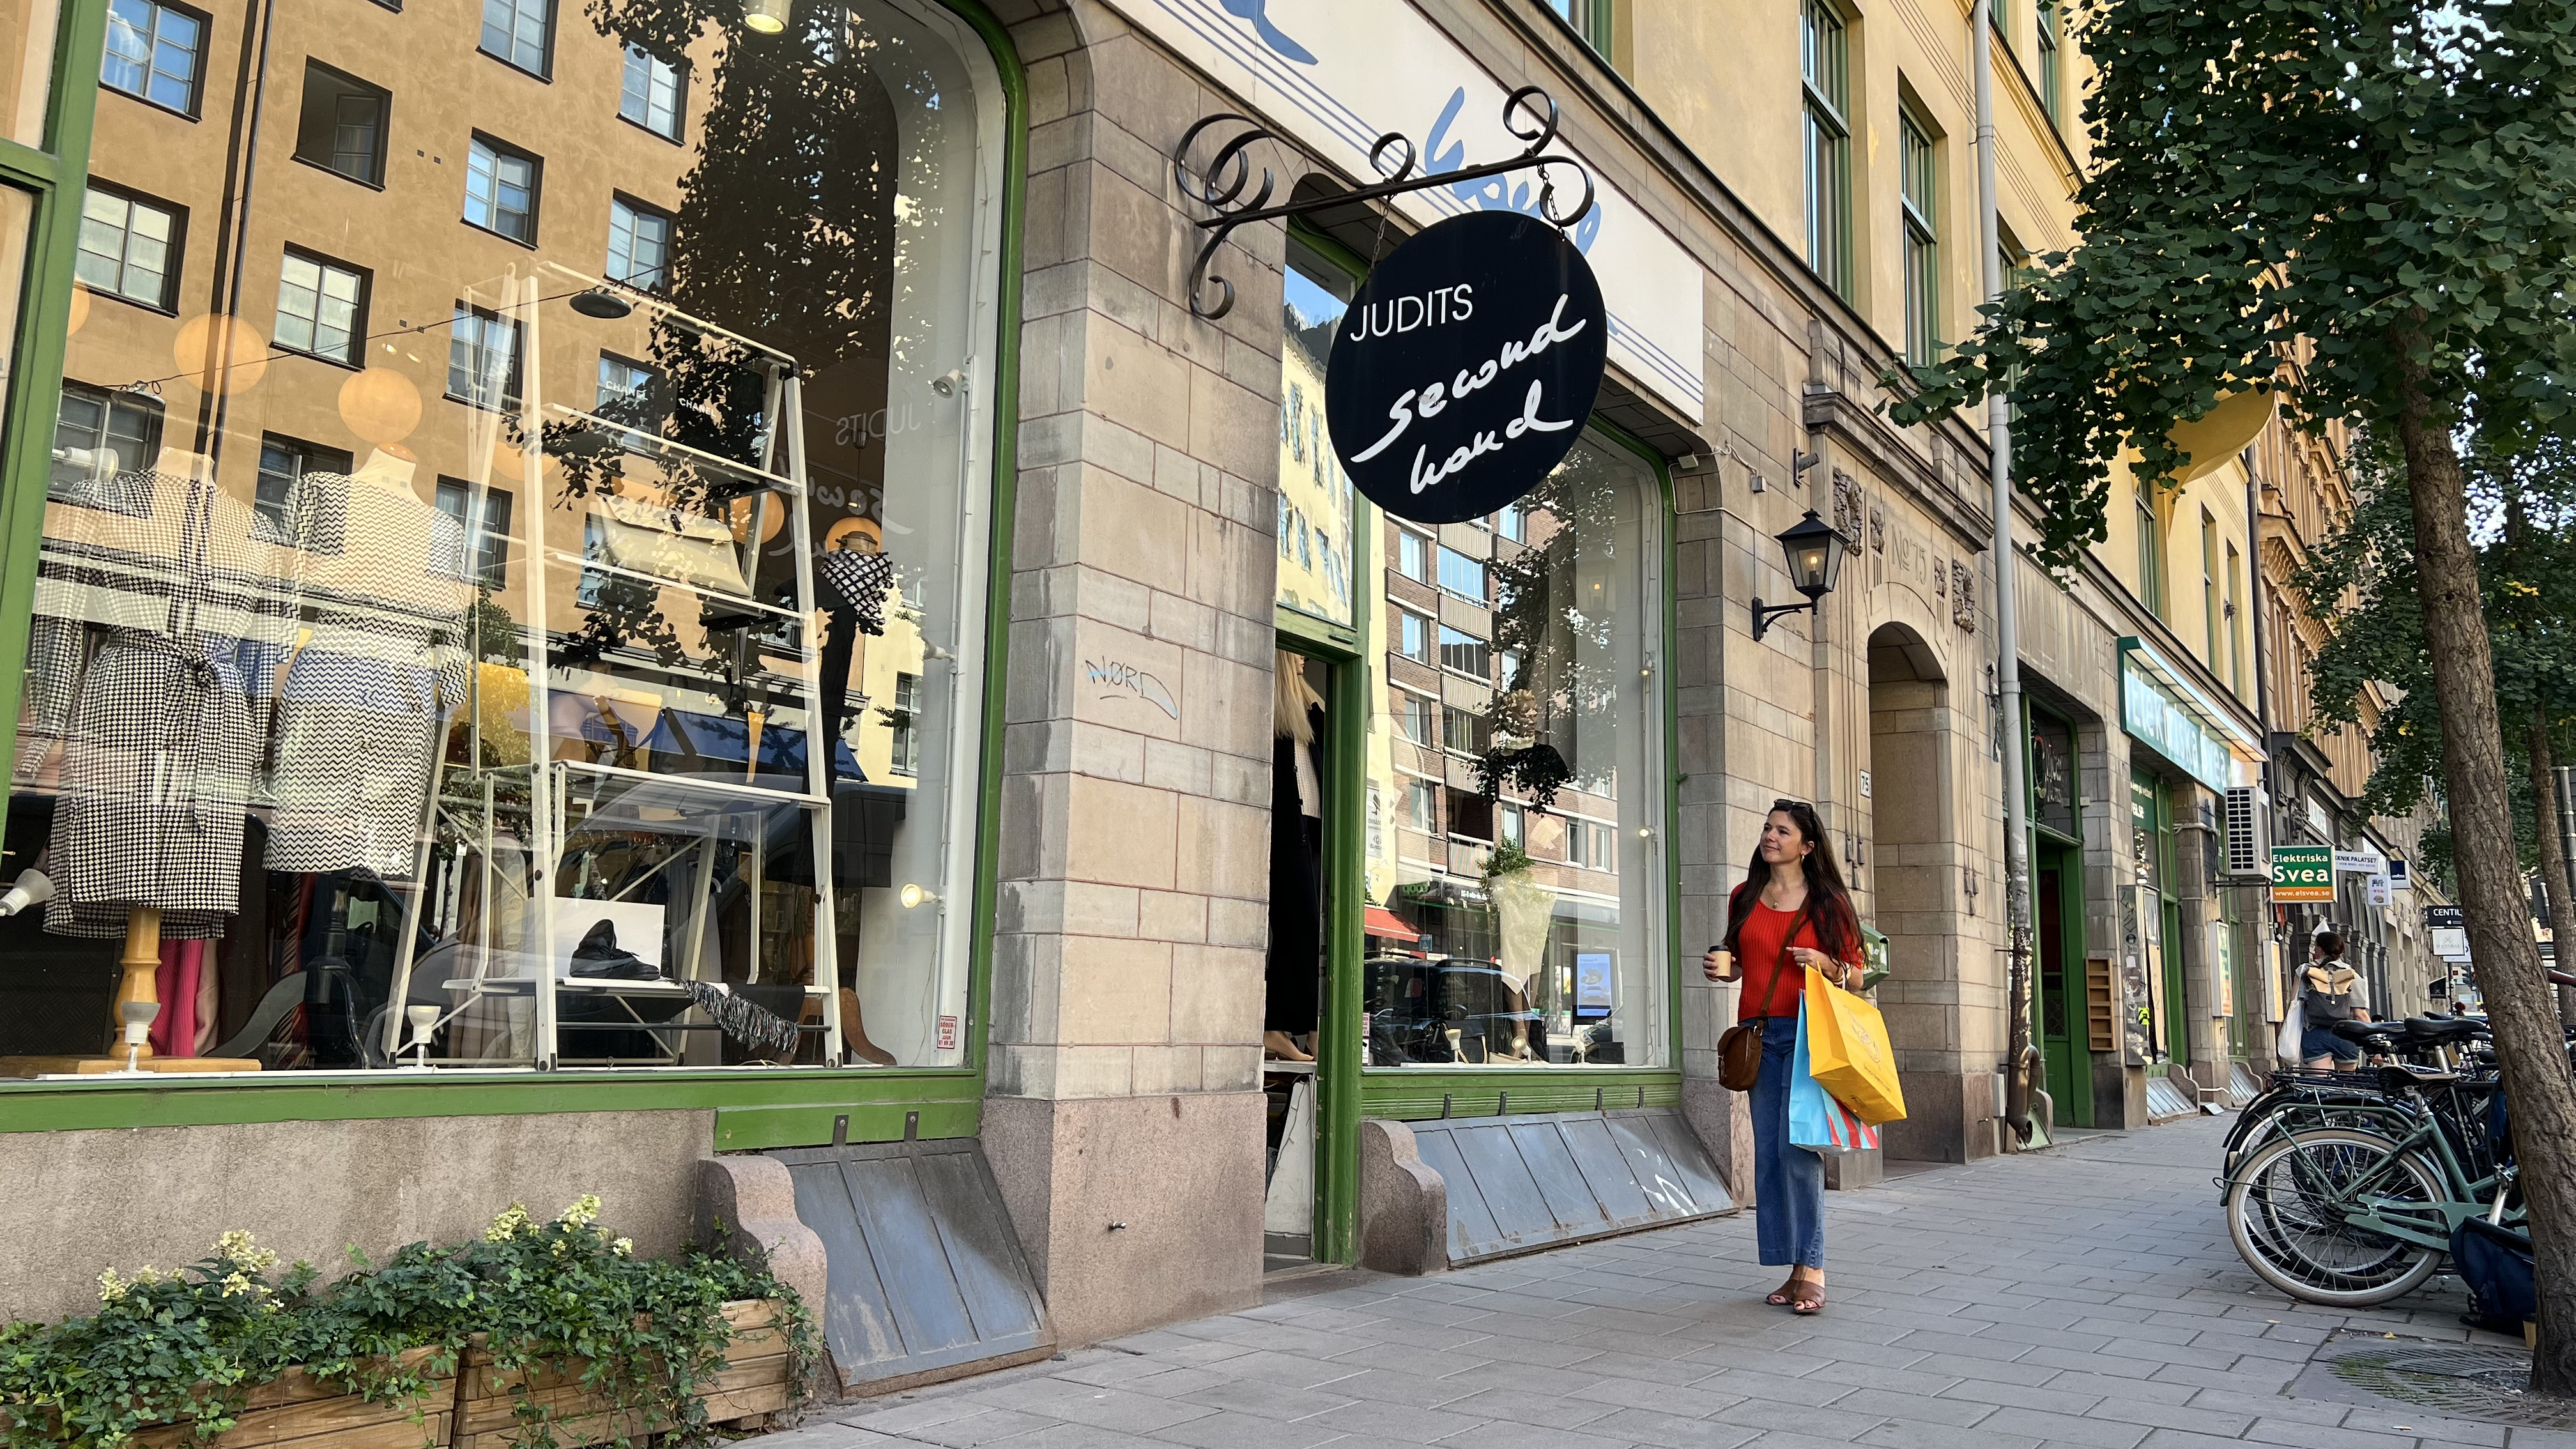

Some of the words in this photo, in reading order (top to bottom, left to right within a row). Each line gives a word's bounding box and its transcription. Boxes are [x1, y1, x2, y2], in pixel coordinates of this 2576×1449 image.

[1350, 283, 1473, 342] JUDITS
[678, 397, 716, 417] CHANEL
[1410, 378, 1574, 495] hand
[1861, 775, 1869, 792] 75
[2273, 853, 2328, 863] Elektriska
[2273, 866, 2329, 883] Svea
[2433, 908, 2463, 917] CENTIL
